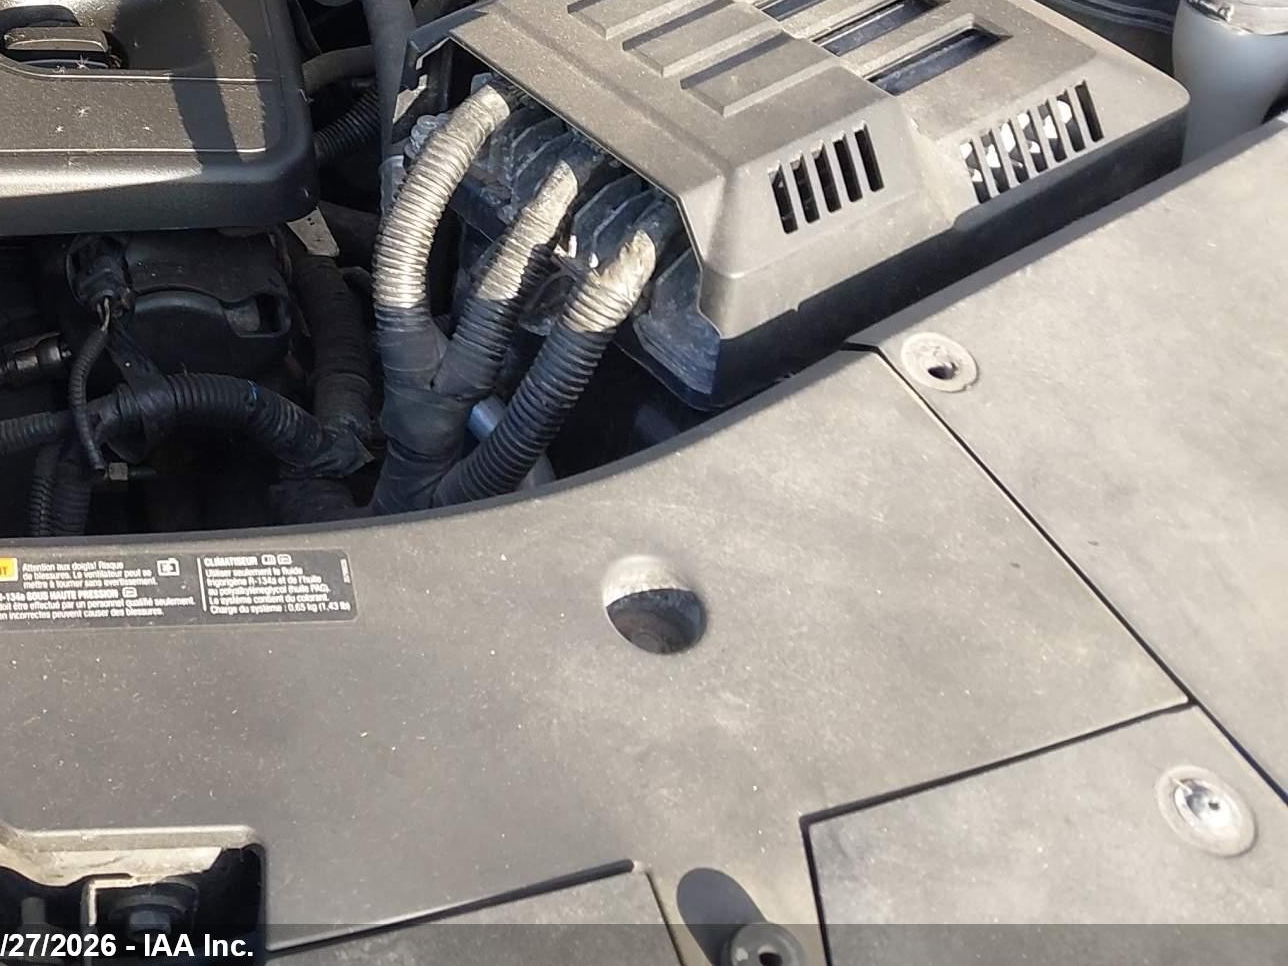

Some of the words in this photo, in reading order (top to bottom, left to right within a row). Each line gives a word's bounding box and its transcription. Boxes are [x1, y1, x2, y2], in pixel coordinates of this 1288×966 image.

[22, 563, 56, 572] Attention
[23, 572, 33, 581] de
[73, 571, 83, 579] Le
[83, 569, 123, 579] ventilateur
[26, 591, 49, 601] SOUS
[50, 590, 77, 600] HAUTE
[77, 589, 119, 600] PRESSION
[62, 601, 75, 610] par
[76, 601, 86, 609] un
[87, 598, 125, 609] personnel
[52, 610, 82, 620] peuvent
[83, 609, 109, 618] causer
[210, 606, 238, 615] Charge
